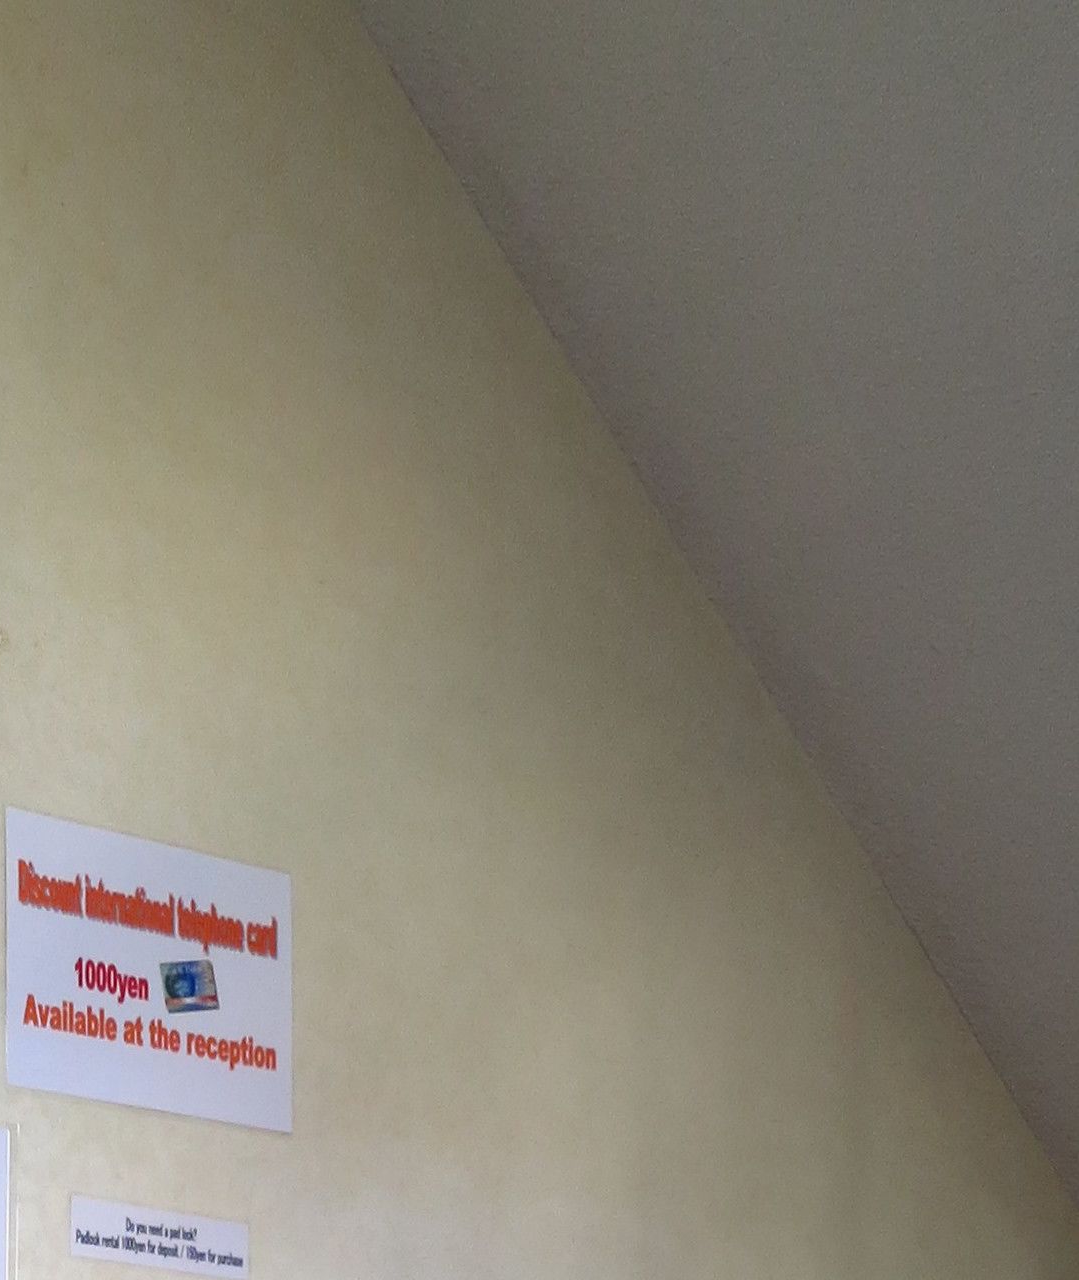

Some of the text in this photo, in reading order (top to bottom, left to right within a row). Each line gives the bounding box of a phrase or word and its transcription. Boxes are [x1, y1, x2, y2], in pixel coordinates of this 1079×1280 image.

[18, 859, 82, 918] Discount
[178, 897, 245, 954] telephone
[247, 916, 277, 960] card
[74, 957, 149, 1004] 1000yen
[23, 994, 277, 1071] Available at the reception
[102, 1234, 120, 1249] rental
[147, 1239, 156, 1254] for
[157, 1241, 179, 1258] deposit
[207, 1248, 216, 1263] for
[217, 1252, 243, 1268] purchase
[125, 1216, 197, 1241] Do you need a pad lock?
